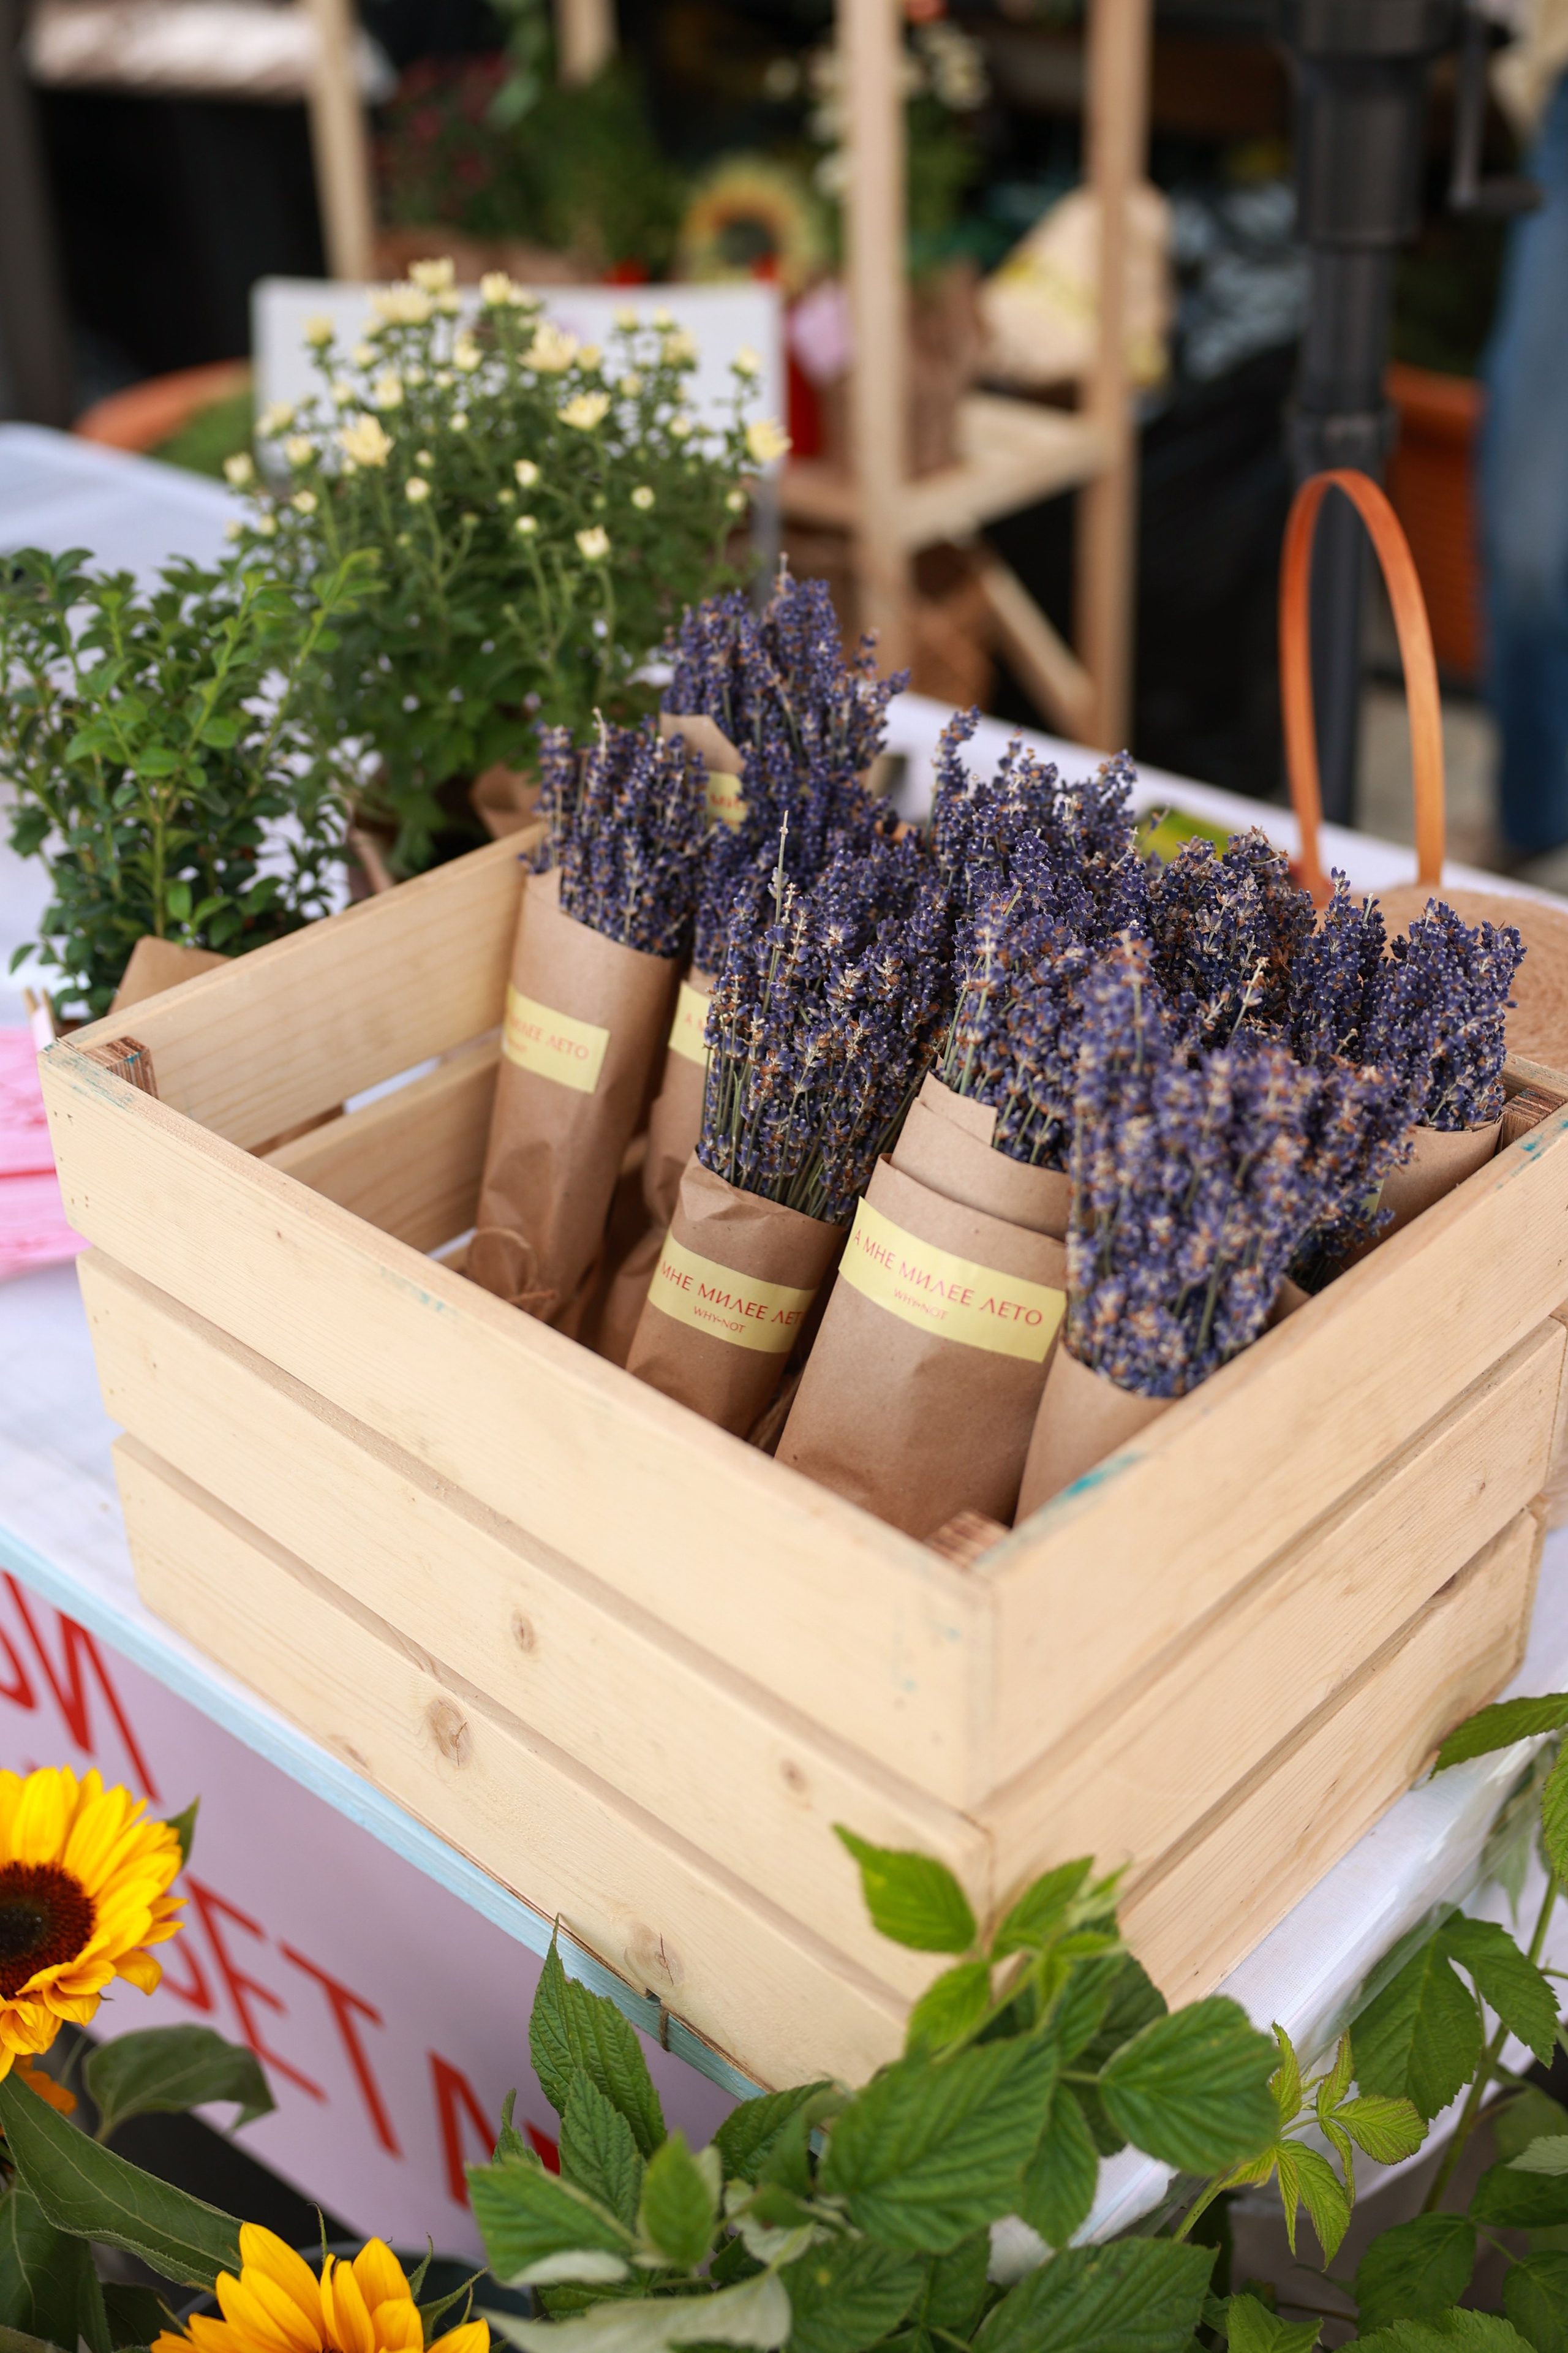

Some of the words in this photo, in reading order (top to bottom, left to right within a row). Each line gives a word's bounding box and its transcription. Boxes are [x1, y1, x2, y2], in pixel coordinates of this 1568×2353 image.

[548, 1033, 590, 1060] ЛЕТО
[660, 1259, 694, 1291] МНЕ
[697, 1282, 769, 1321] МИЛЕЕ
[771, 1309, 806, 1326] ЛЕТ
[853, 1228, 862, 1246] А
[862, 1236, 896, 1270] МНЕ
[898, 1261, 976, 1307] МИЛЕЕ
[979, 1297, 1043, 1326] ЛЕТО
[693, 1305, 746, 1334] WHY-NOT
